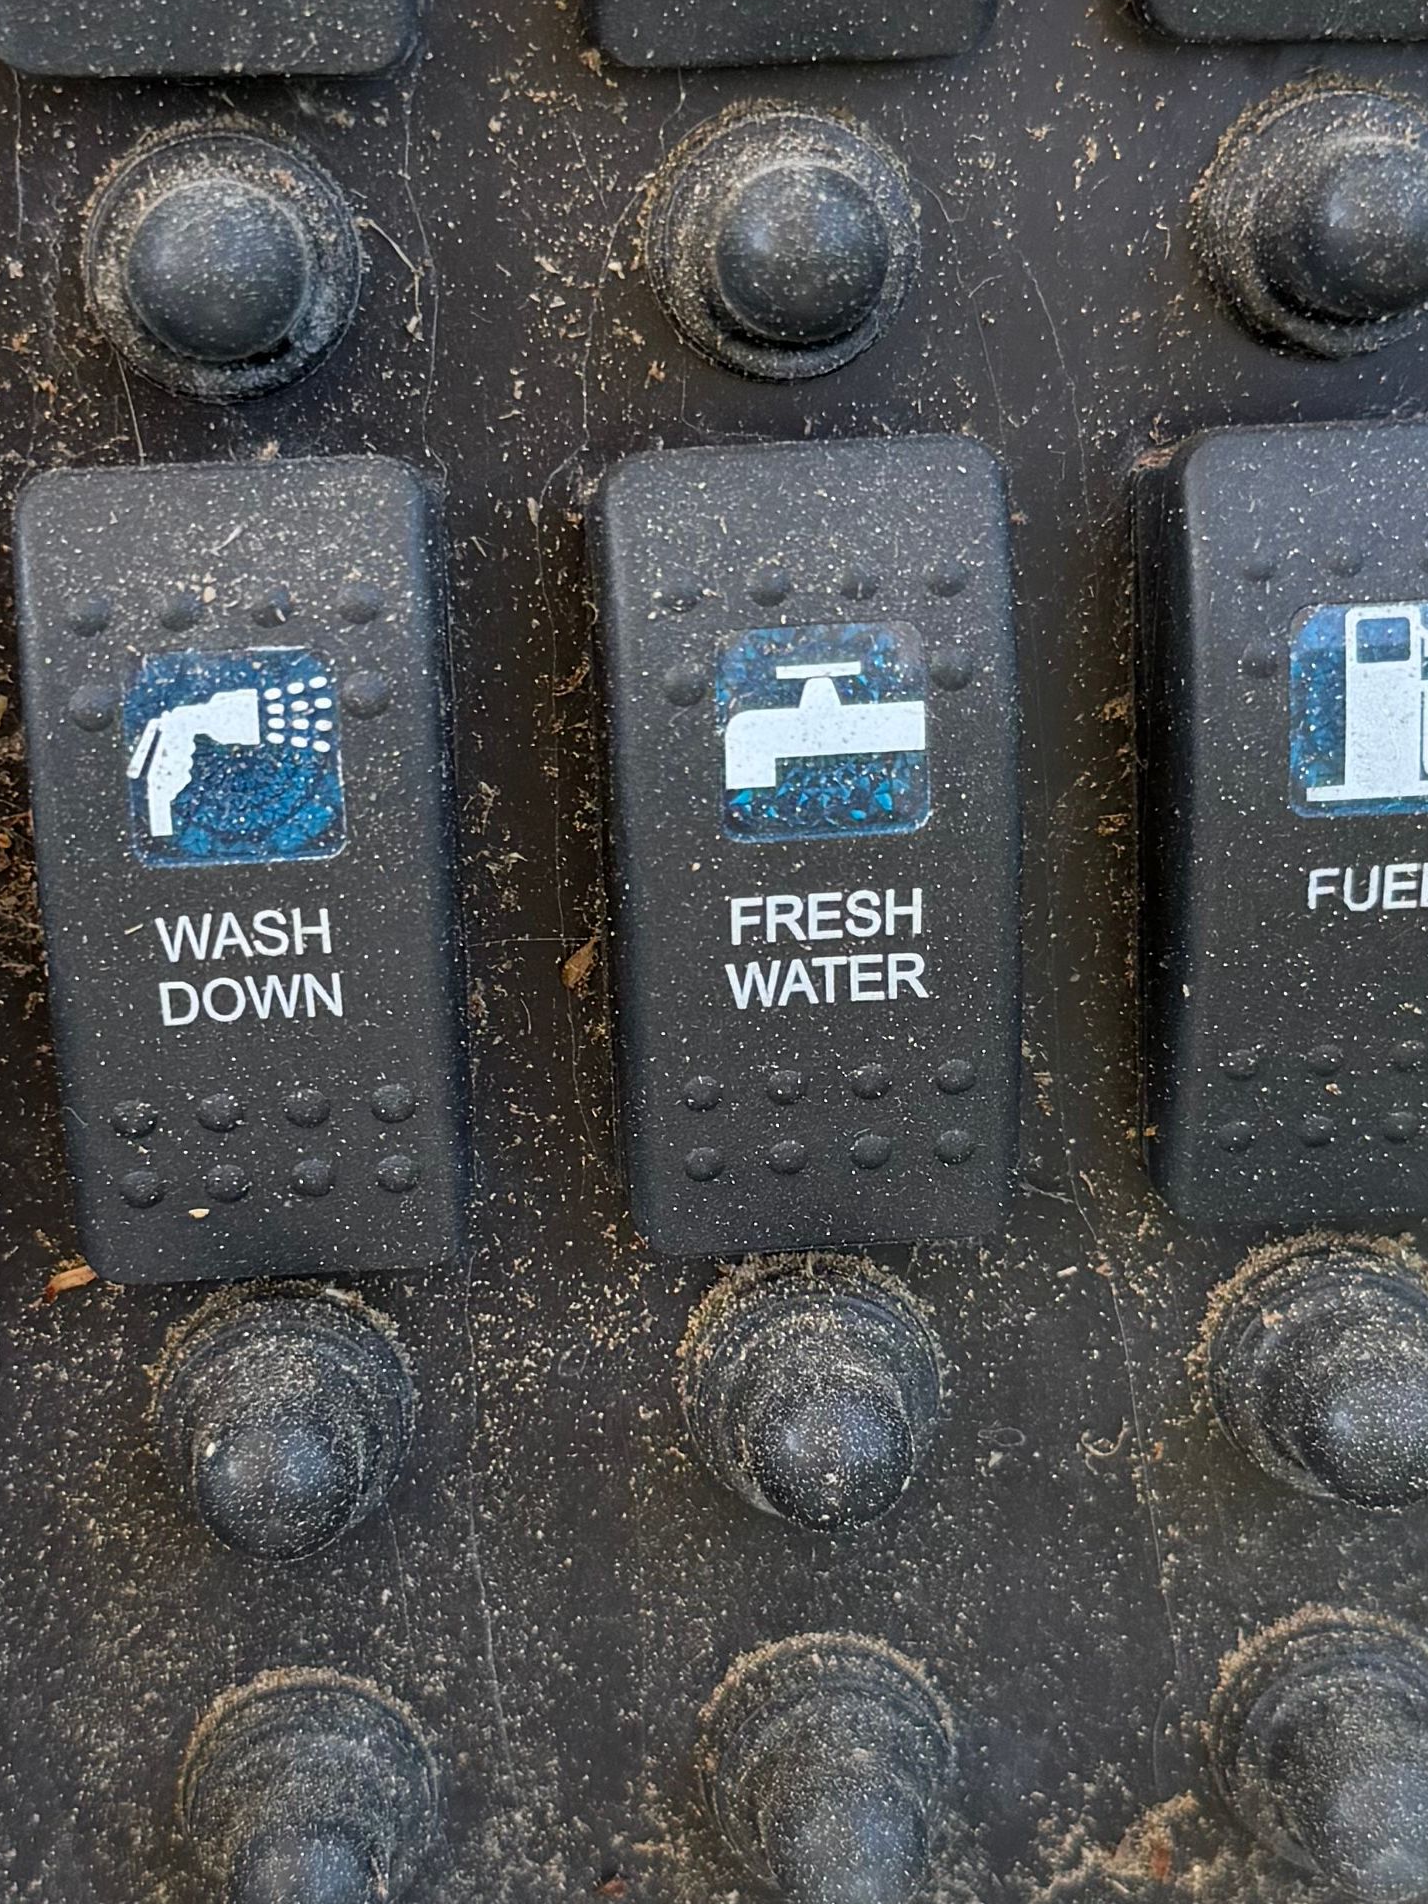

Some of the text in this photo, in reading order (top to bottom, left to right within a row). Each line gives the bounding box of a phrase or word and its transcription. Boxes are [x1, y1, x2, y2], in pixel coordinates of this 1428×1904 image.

[156, 908, 333, 962] WASH
[729, 887, 926, 946] FRESH
[158, 970, 345, 1029] DOWN
[725, 951, 930, 1011] WATER
